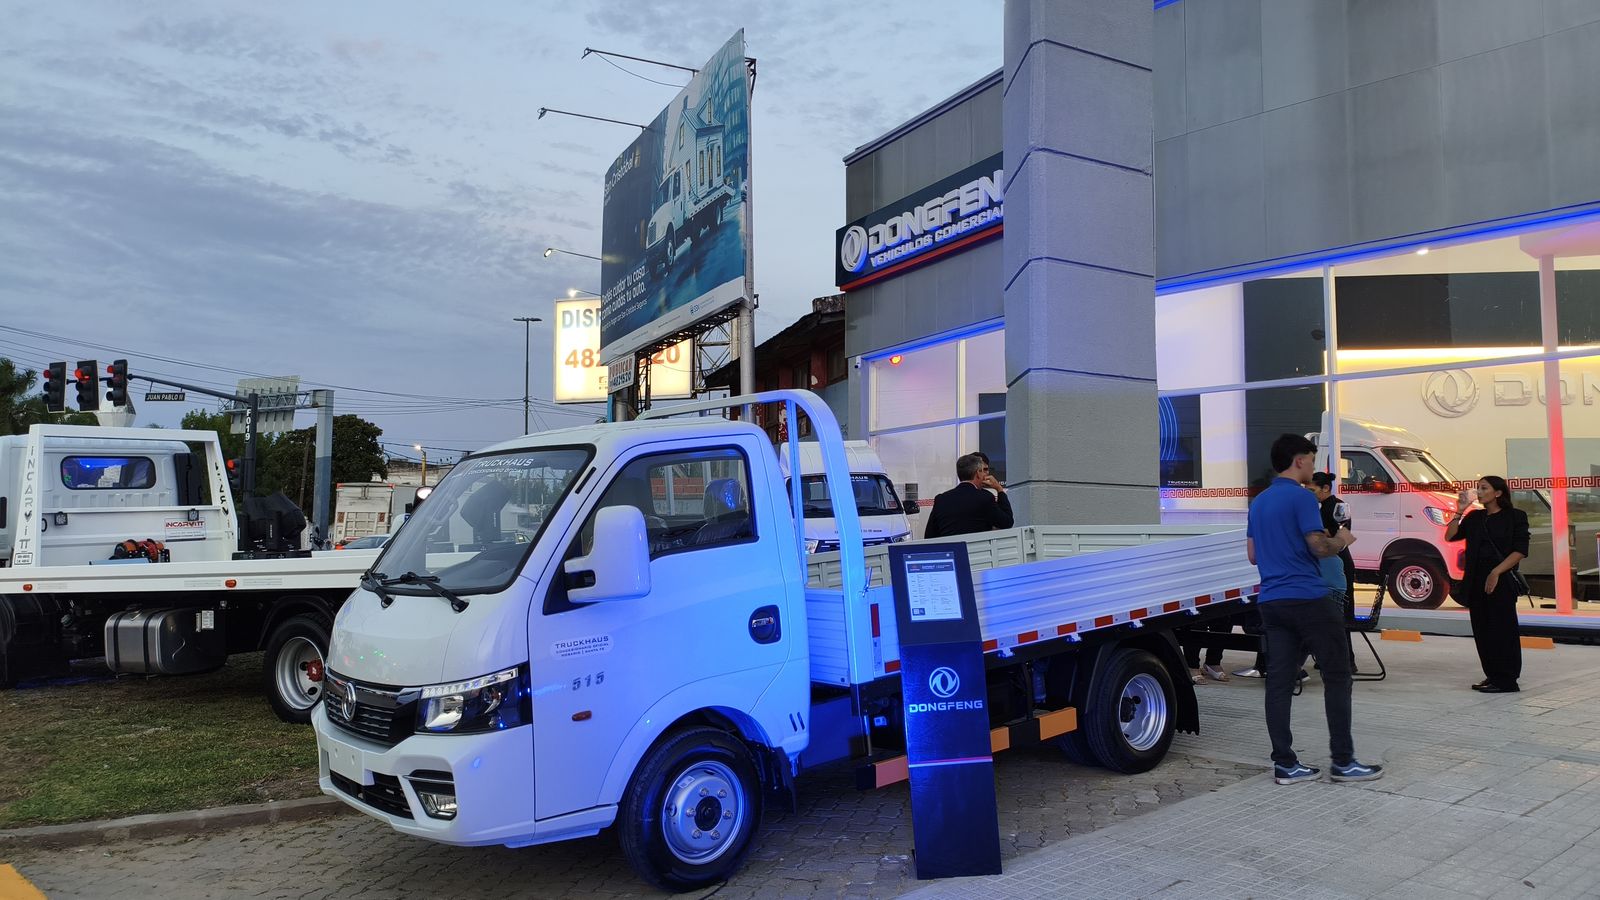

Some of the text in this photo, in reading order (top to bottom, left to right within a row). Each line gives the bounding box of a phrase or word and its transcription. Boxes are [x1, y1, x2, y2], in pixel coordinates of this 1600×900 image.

[870, 234, 933, 268] VEHICULOS
[147, 393, 161, 401] JUAN
[161, 393, 178, 401] PABLO
[244, 408, 252, 441] F019
[555, 635, 609, 649] TRUCKHAUS
[572, 671, 605, 691] 515
[908, 700, 983, 713] DONGFENG
